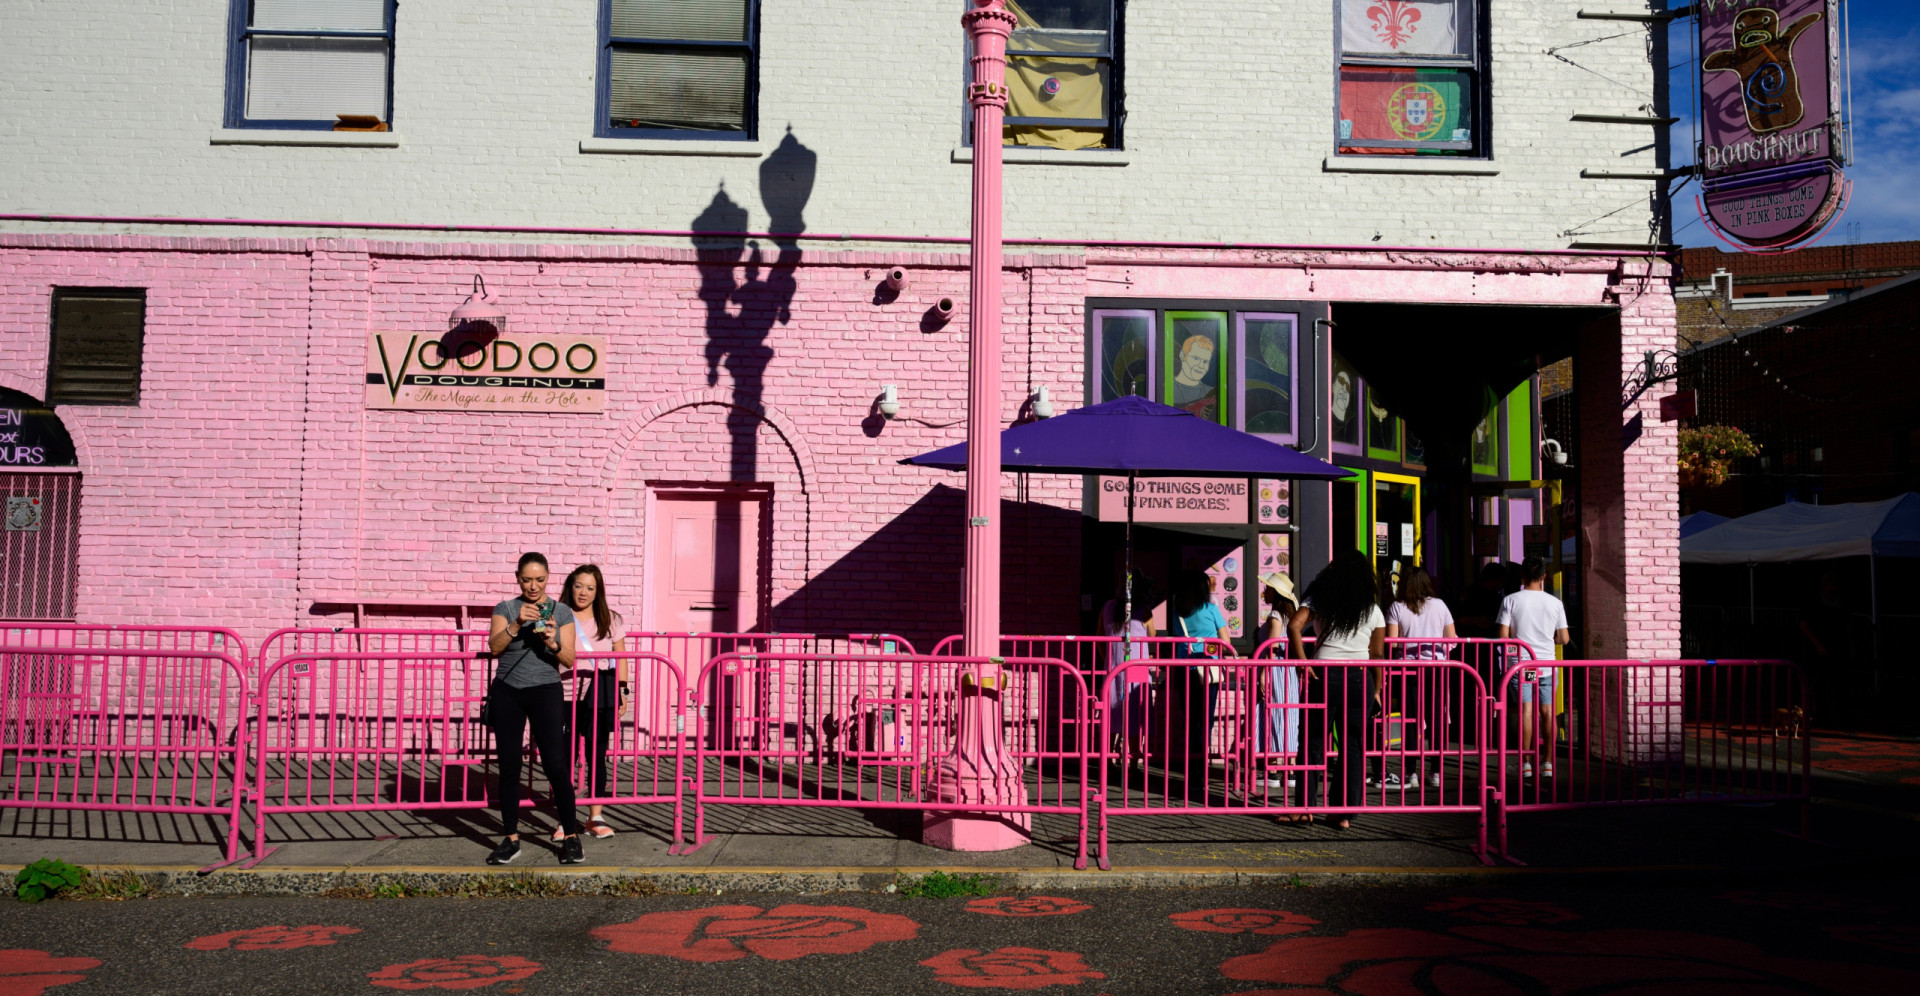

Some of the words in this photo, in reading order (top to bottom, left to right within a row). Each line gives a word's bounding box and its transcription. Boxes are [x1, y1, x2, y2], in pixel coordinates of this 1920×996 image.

[1707, 128, 1825, 171] DOUGHNUT
[1722, 198, 1745, 213] GOOD
[1750, 191, 1784, 209] THINGS
[1788, 186, 1814, 202] COME
[1731, 214, 1742, 228] IN
[1747, 209, 1770, 225] PINK
[1775, 204, 1806, 220] BOXES
[375, 334, 598, 404] VOODOO
[413, 375, 596, 388] DOUGHNUT
[415, 387, 438, 402] The
[441, 390, 480, 408] Magic
[484, 394, 496, 404] is
[502, 394, 515, 403] in
[517, 391, 539, 404] the
[544, 391, 580, 406] Hole
[1147, 481, 1201, 495] THINGS
[1204, 482, 1246, 496] COME
[1139, 496, 1173, 508] PINK
